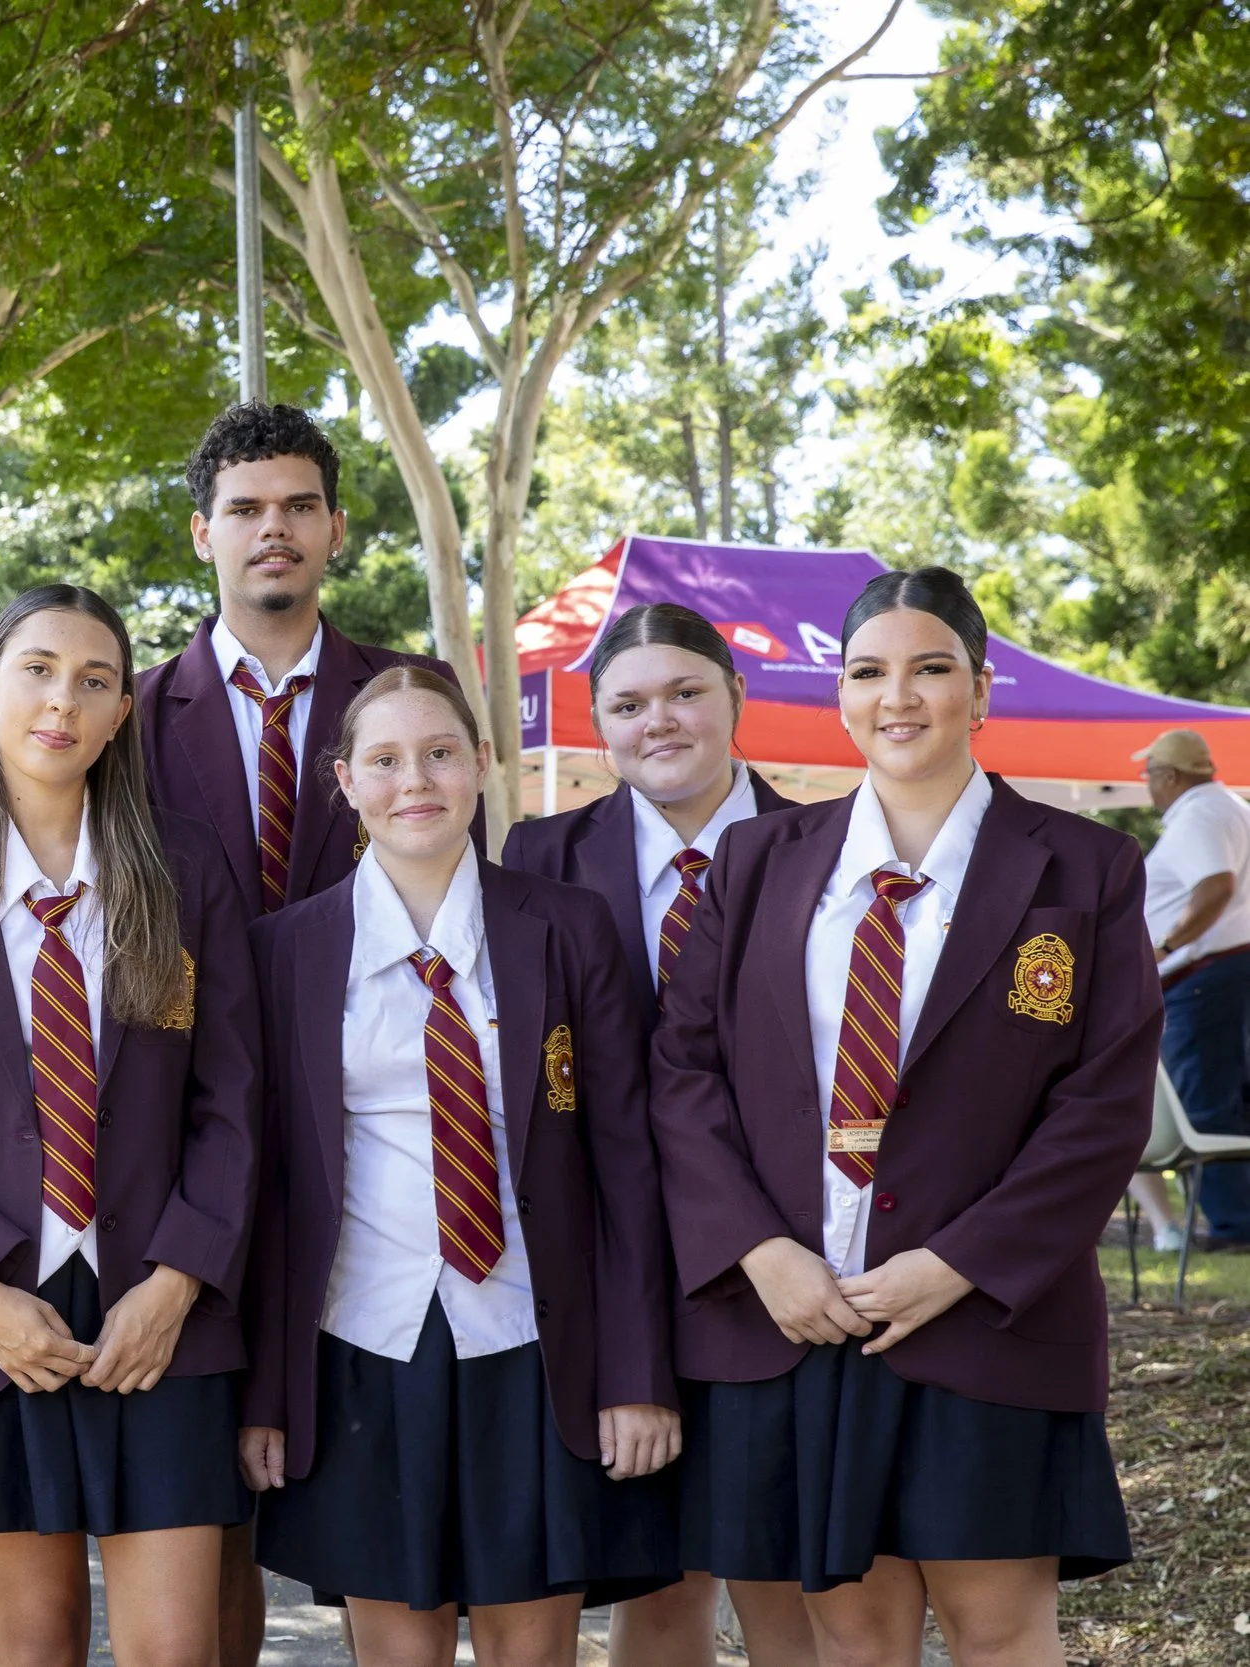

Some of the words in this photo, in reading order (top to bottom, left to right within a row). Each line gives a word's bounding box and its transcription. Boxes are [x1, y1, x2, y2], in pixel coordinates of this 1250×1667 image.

[1020, 937, 1043, 954] FAITHFUL
[1017, 962, 1030, 997] CHRISTIAN
[1027, 996, 1063, 1009] BROTHERS
[1060, 972, 1071, 1000] COLLEGE
[1034, 1010, 1057, 1020] JAMES
